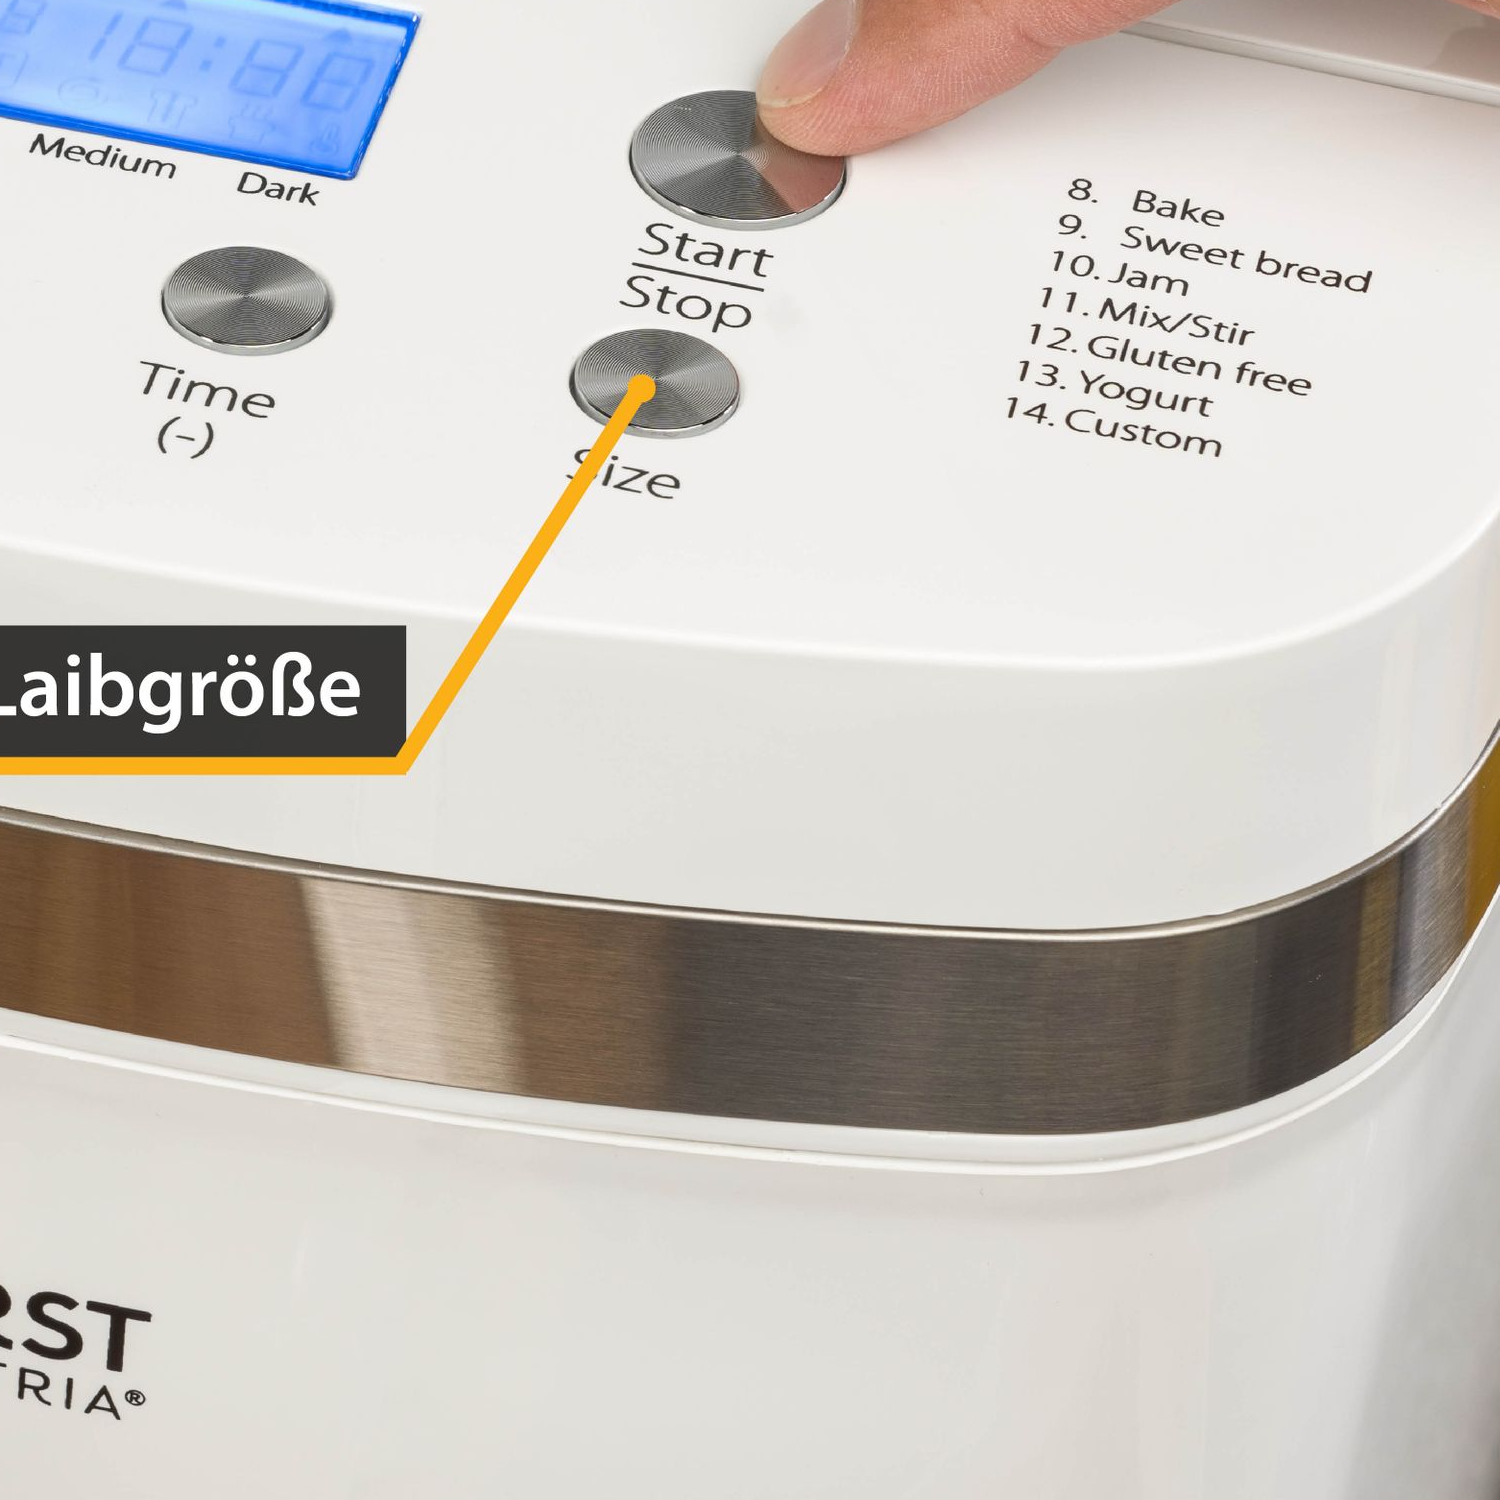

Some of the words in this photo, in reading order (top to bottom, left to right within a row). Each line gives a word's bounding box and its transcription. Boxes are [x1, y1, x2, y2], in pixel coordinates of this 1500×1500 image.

[29, 133, 176, 179] Medium
[237, 172, 319, 206] Dark
[1068, 179, 1097, 203] 8.
[1133, 190, 1224, 227] Bake
[638, 223, 774, 277] Start
[1054, 251, 1099, 280] 10.
[1108, 263, 1188, 296] Jam
[1059, 214, 1086, 239] 9.
[1120, 226, 1244, 269] Sweet
[1256, 250, 1372, 293] bread
[620, 276, 751, 333] Stop
[1042, 287, 1088, 316] 11.
[1099, 298, 1255, 345] Mix/Stir
[1031, 324, 1077, 353] 12.
[1088, 336, 1221, 379] Gluten
[1236, 362, 1311, 396] free
[140, 361, 275, 418] Time
[1020, 361, 1065, 389] 13.
[1081, 370, 1213, 417] Yogurt
[1008, 397, 1054, 426] 14.
[1065, 409, 1221, 457] Custom
